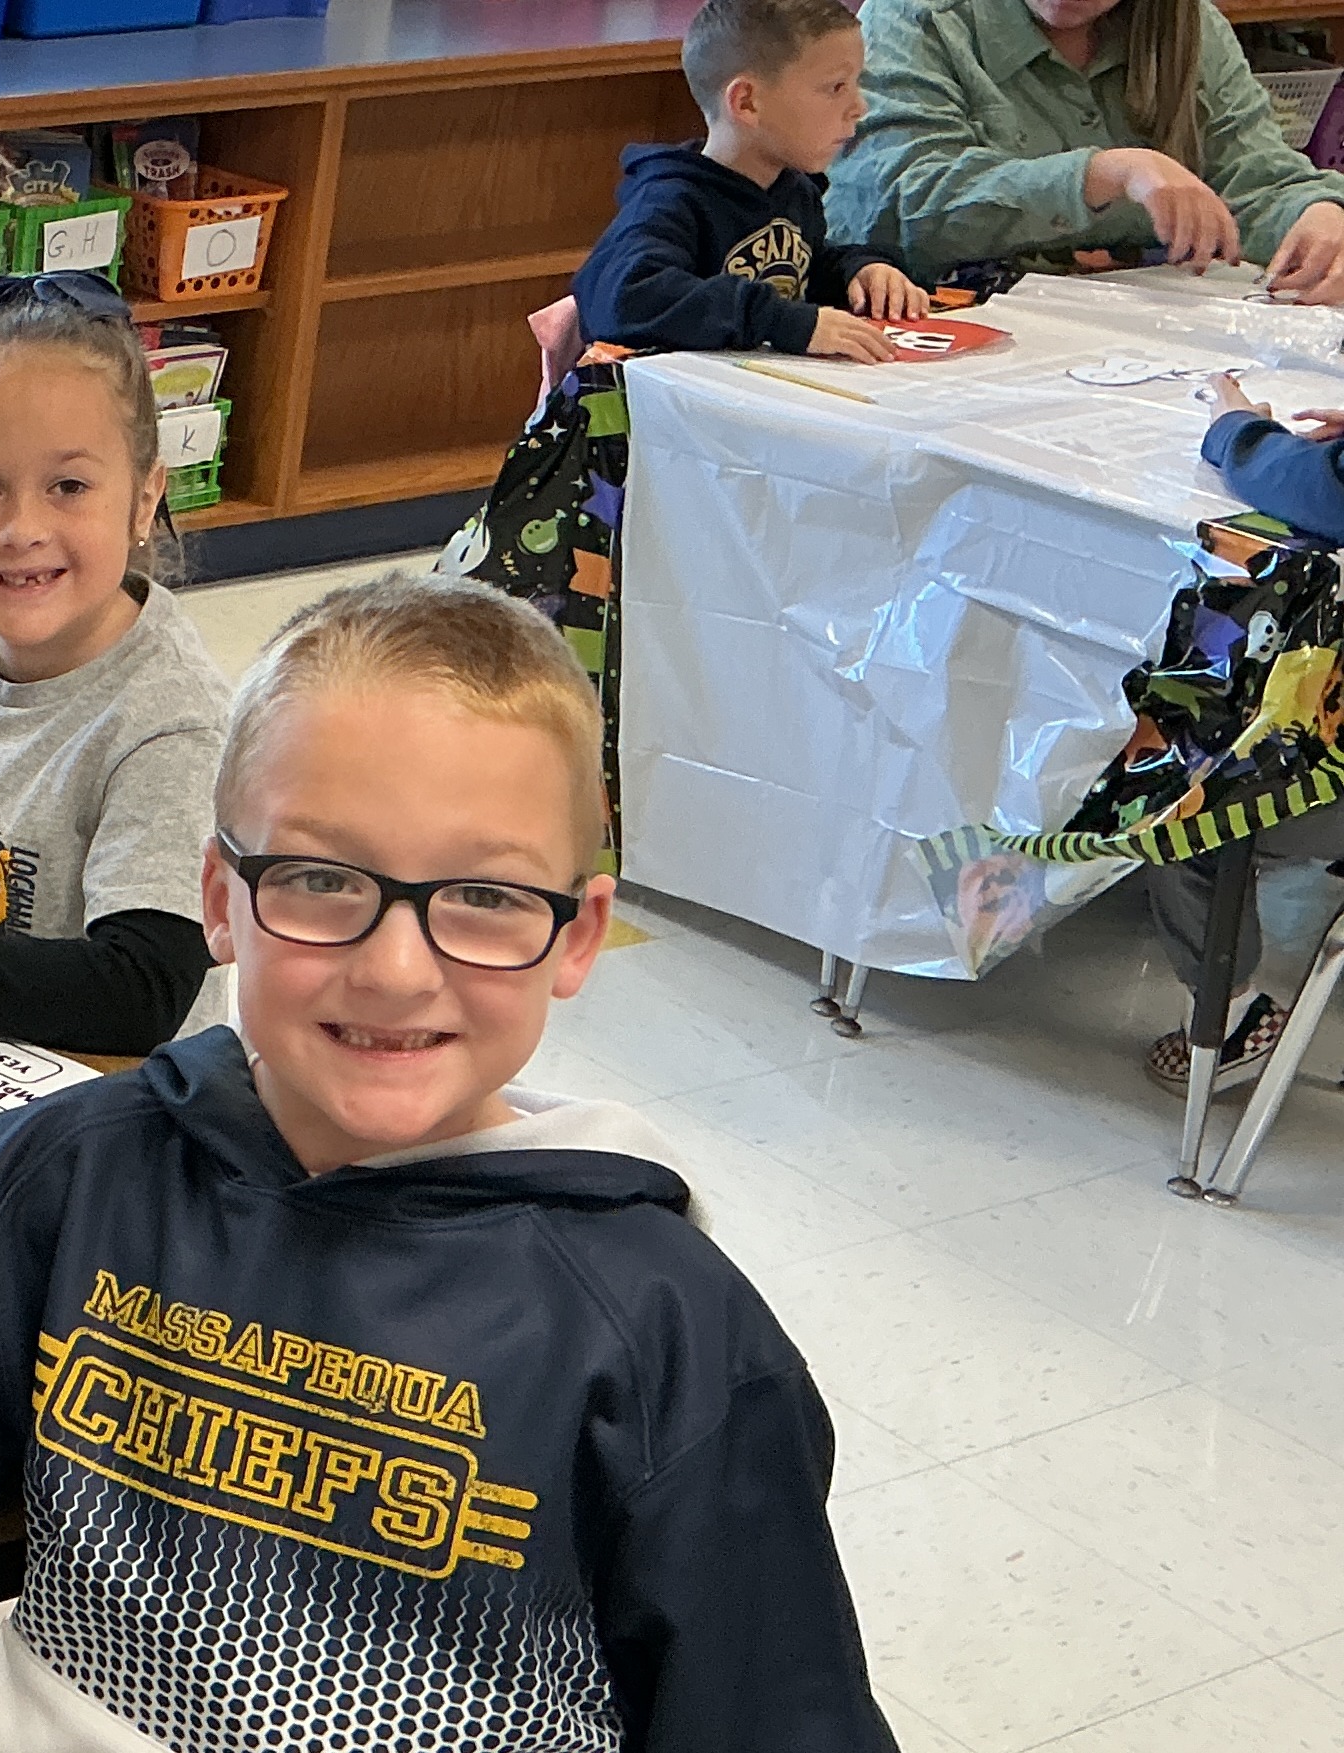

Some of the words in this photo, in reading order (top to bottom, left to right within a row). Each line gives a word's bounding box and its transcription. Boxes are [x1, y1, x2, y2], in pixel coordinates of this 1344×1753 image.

[23, 179, 61, 195] CITY
[143, 164, 181, 180] TRASH
[82, 221, 100, 255] H
[181, 424, 197, 457] K
[83, 1267, 487, 1440] MASSAPEQUA
[51, 1353, 456, 1551] CHIEFS
